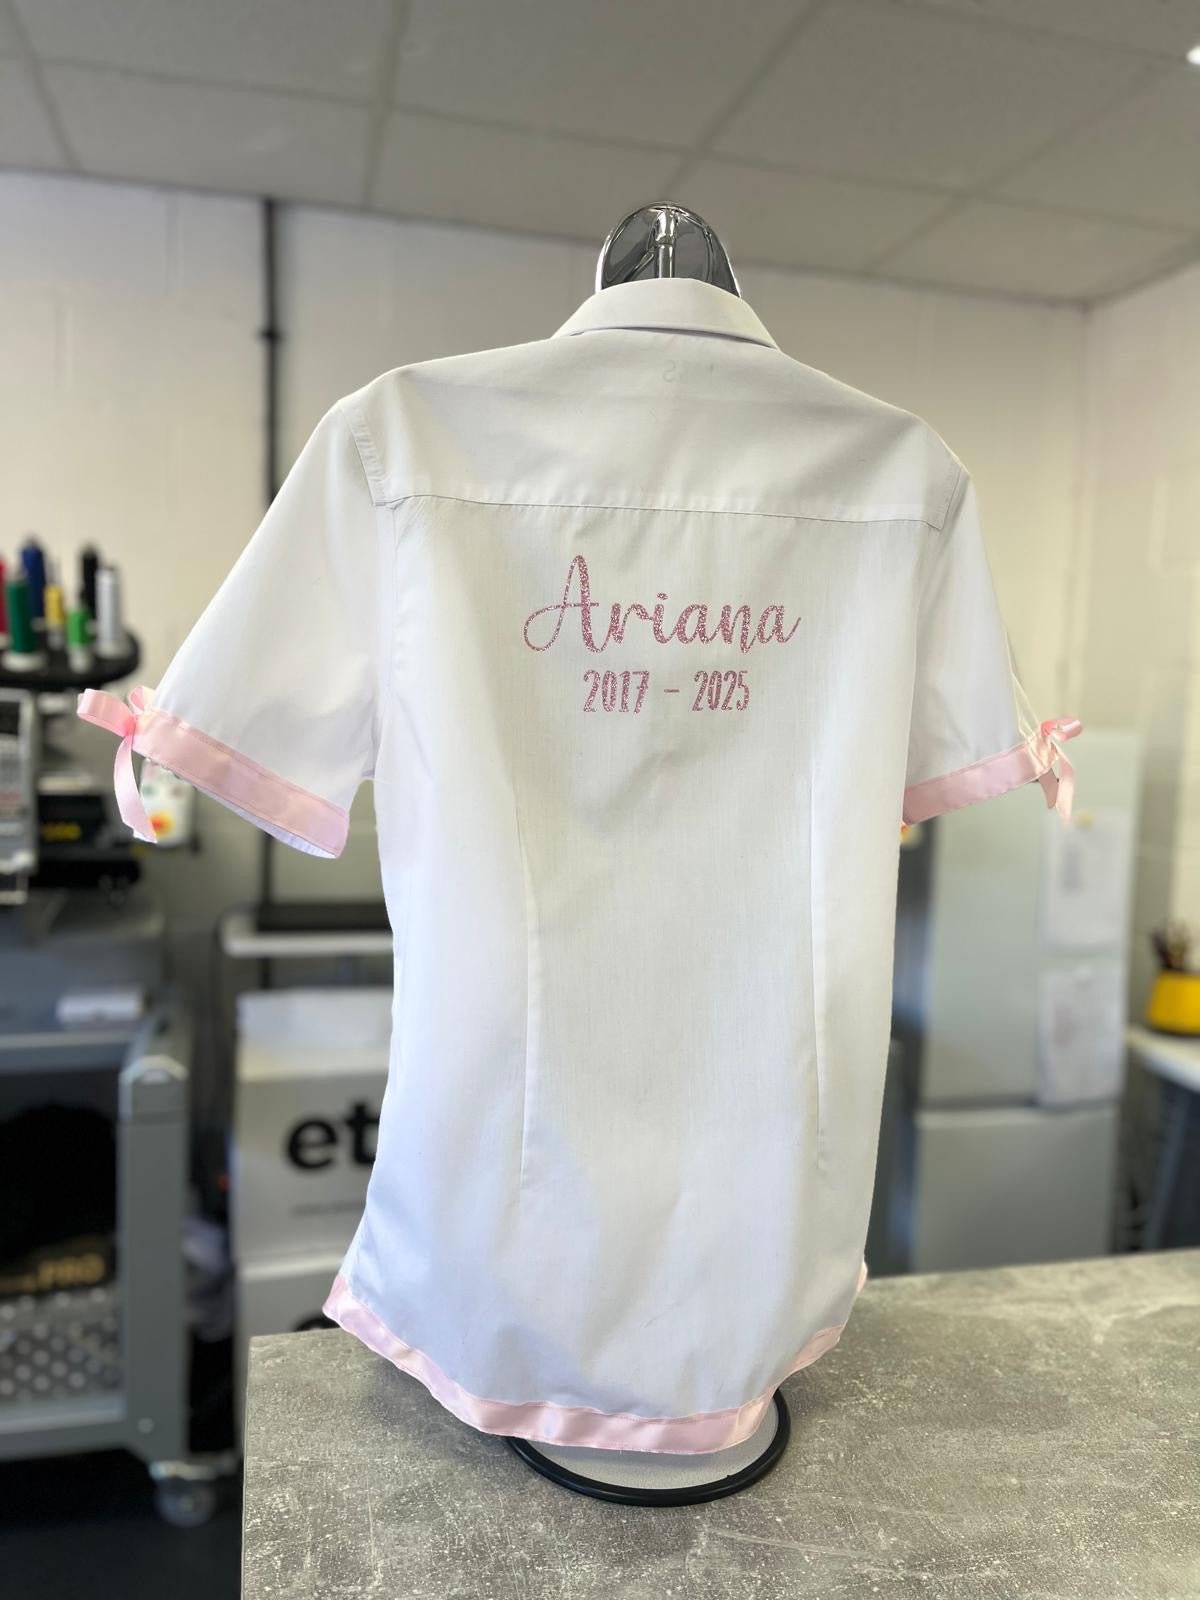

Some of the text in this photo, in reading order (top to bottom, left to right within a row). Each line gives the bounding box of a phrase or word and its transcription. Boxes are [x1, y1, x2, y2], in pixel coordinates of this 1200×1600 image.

[524, 554, 801, 653] Ariana
[583, 669, 650, 714] 2017
[692, 669, 751, 712] 2025
